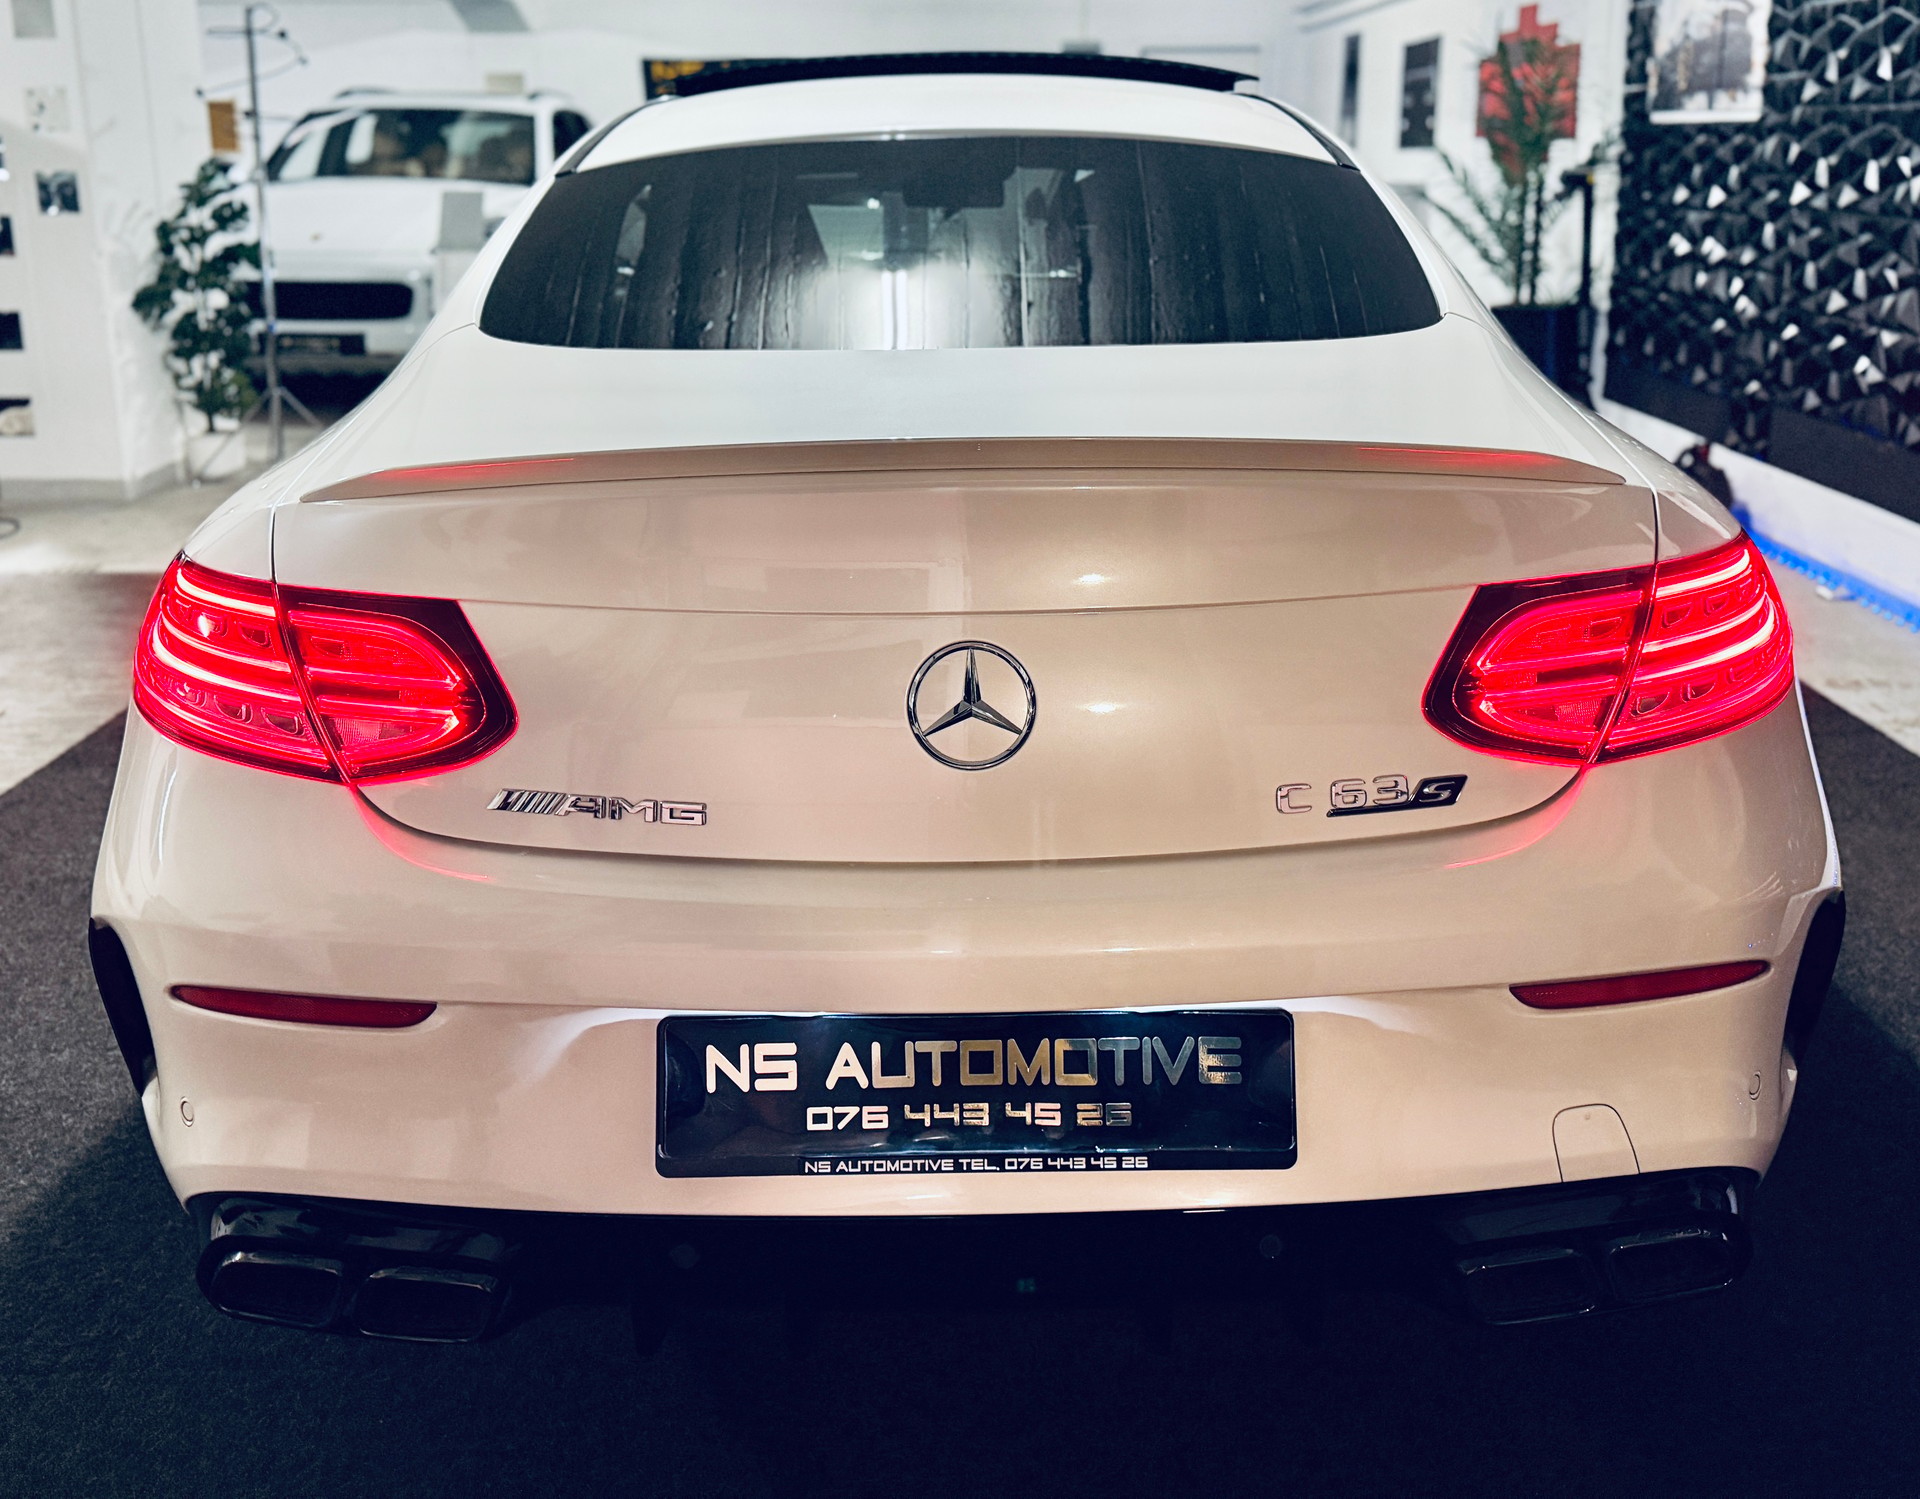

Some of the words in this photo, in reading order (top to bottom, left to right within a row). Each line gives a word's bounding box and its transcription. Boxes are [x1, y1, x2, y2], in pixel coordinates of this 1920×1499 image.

[554, 793, 707, 826] AMG
[1276, 783, 1312, 814] C
[706, 1042, 798, 1094] NS
[825, 1036, 1242, 1090] AUTOMOTIVE
[806, 1105, 889, 1131] 076
[904, 1102, 990, 1127] 443
[1005, 1102, 1062, 1127] 45
[1076, 1102, 1133, 1127] 26
[804, 1161, 832, 1174] NS
[835, 1159, 955, 1173] AUTOMOTIVE
[1004, 1157, 1044, 1170] 076
[1047, 1156, 1087, 1169] 443
[1090, 1156, 1118, 1169] 45
[1121, 1156, 1149, 1169] 26
